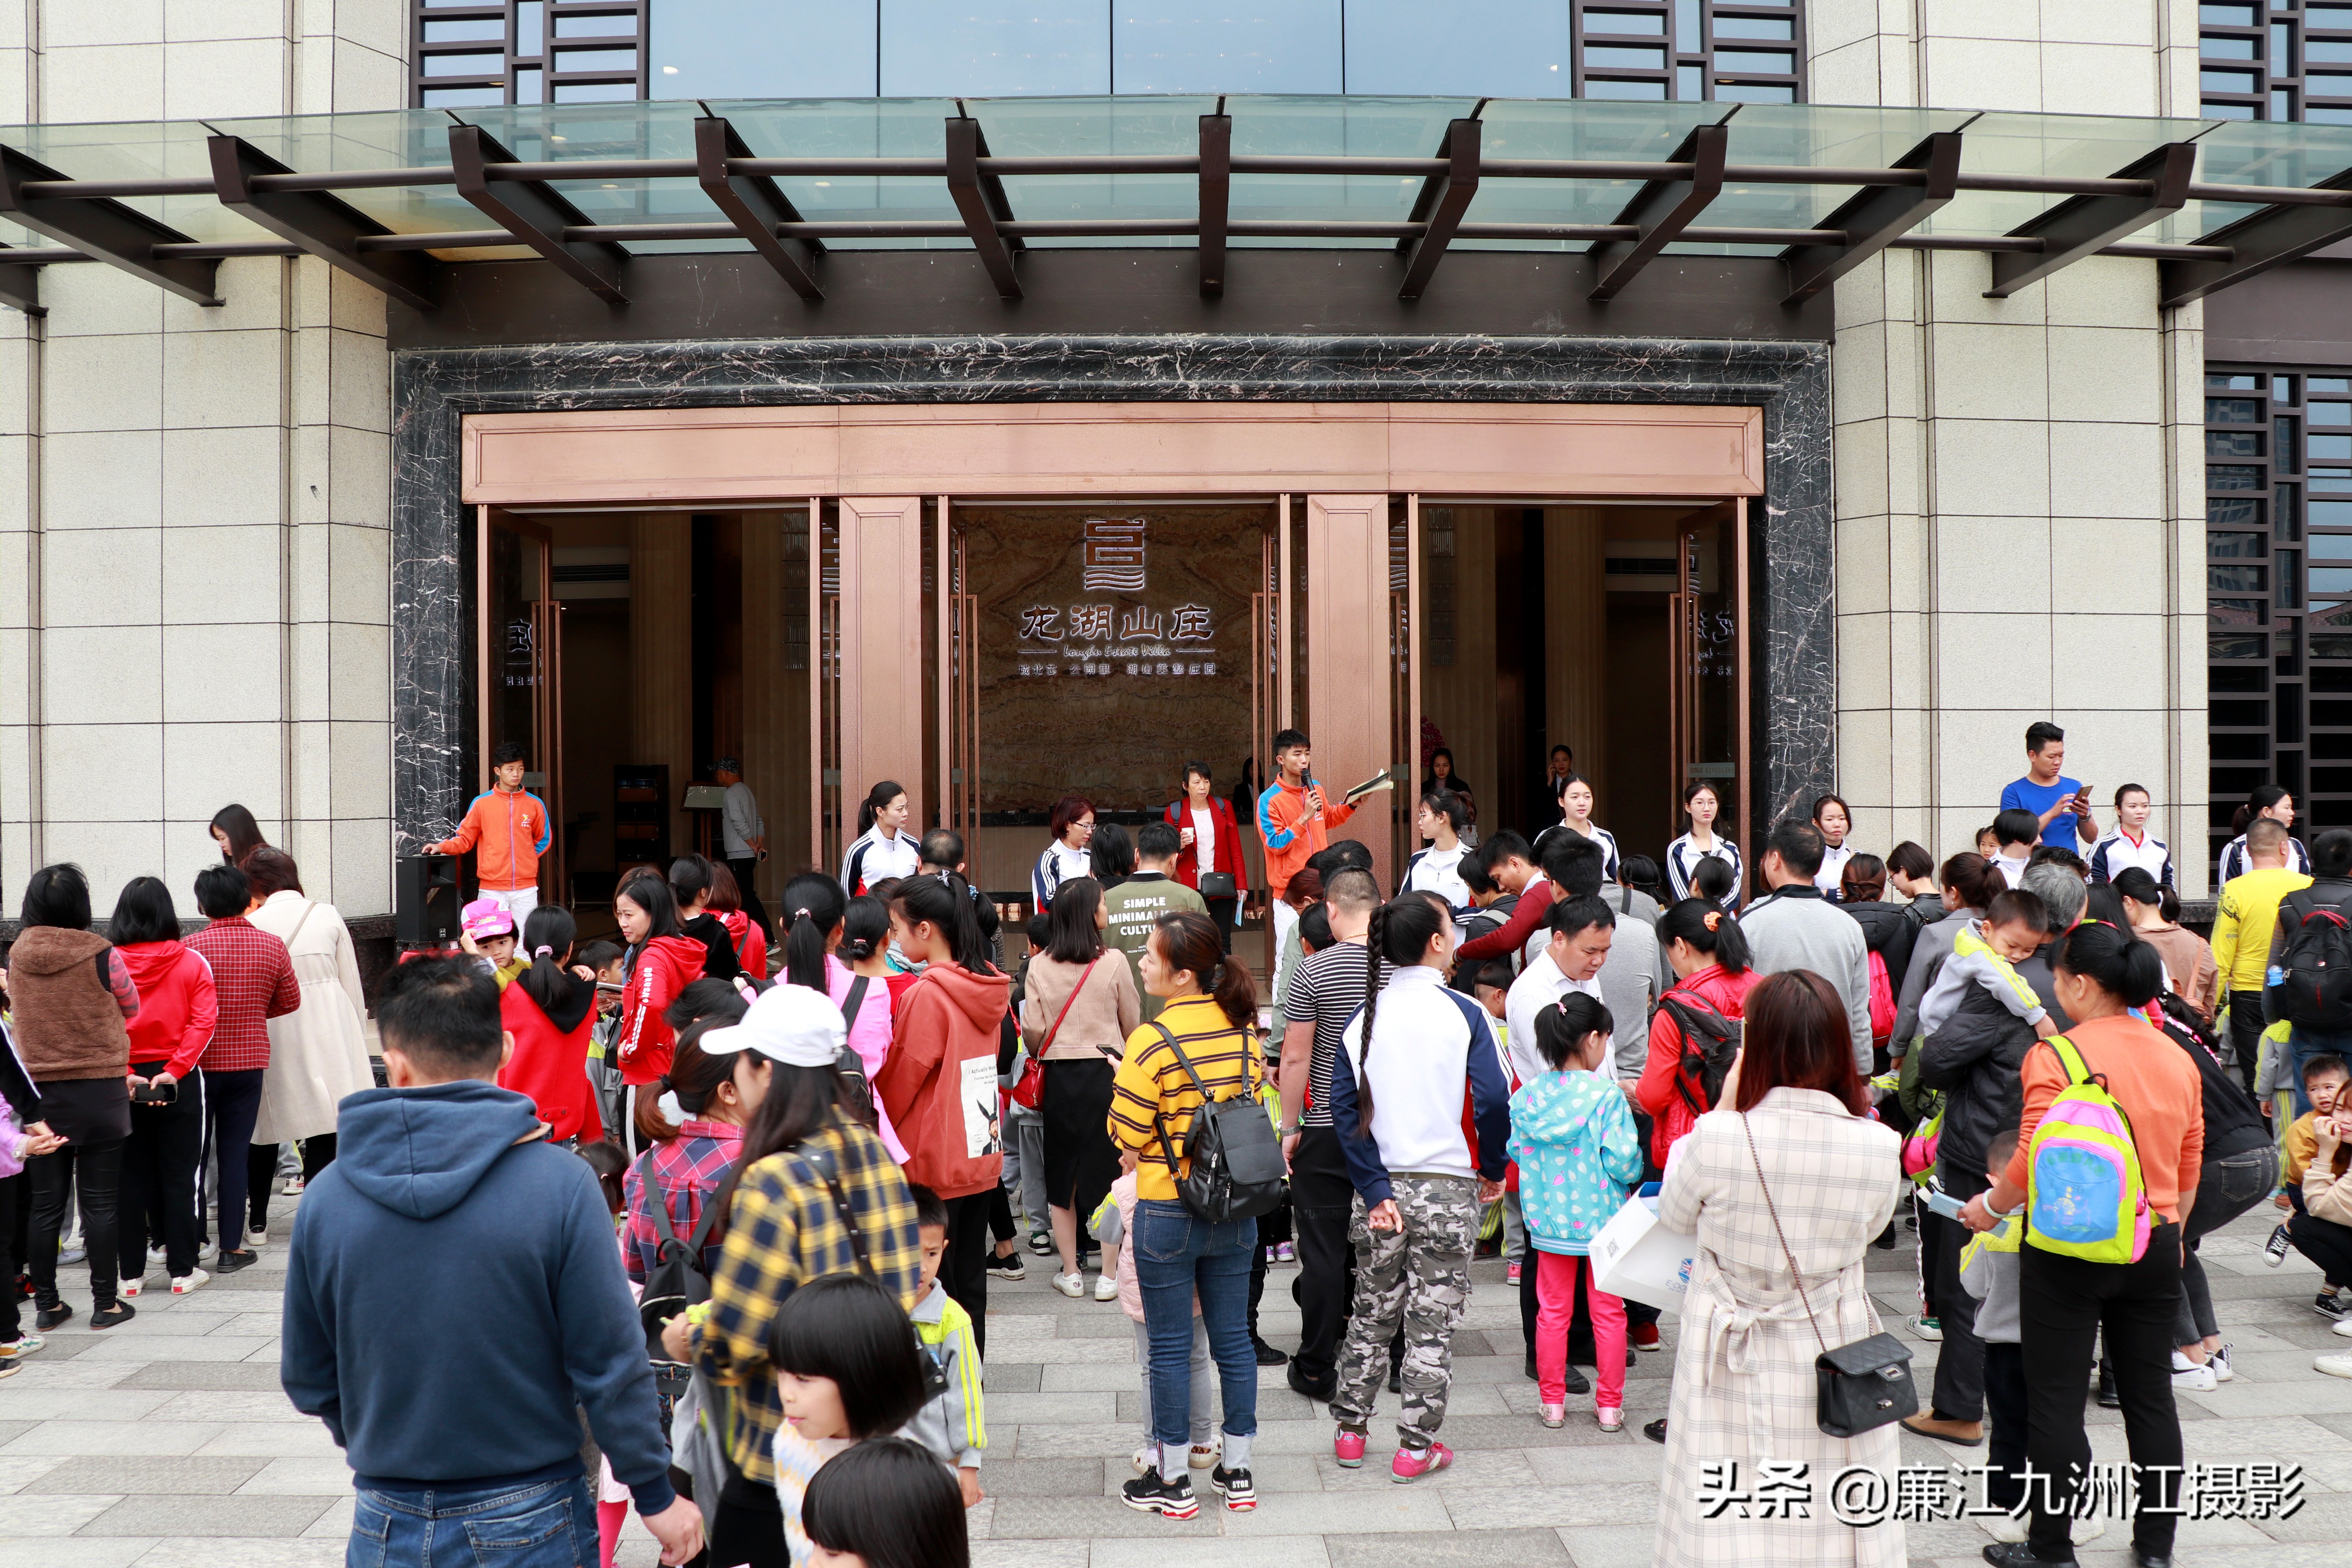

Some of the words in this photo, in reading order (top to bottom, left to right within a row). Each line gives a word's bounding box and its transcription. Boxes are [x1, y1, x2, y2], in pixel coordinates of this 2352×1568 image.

[1020, 604, 1213, 639] 龙湖山庄
[1063, 644, 1101, 660] Longhu
[1104, 644, 1138, 657] Estate
[1141, 644, 1171, 656] Villa
[1019, 664, 1057, 675] 城北芯
[1069, 664, 1111, 675] 公园里
[1127, 663, 1215, 675] 湖山美墅庄园
[1123, 897, 1166, 909] SIMPLE
[1232, 1480, 1249, 1489] STOR
